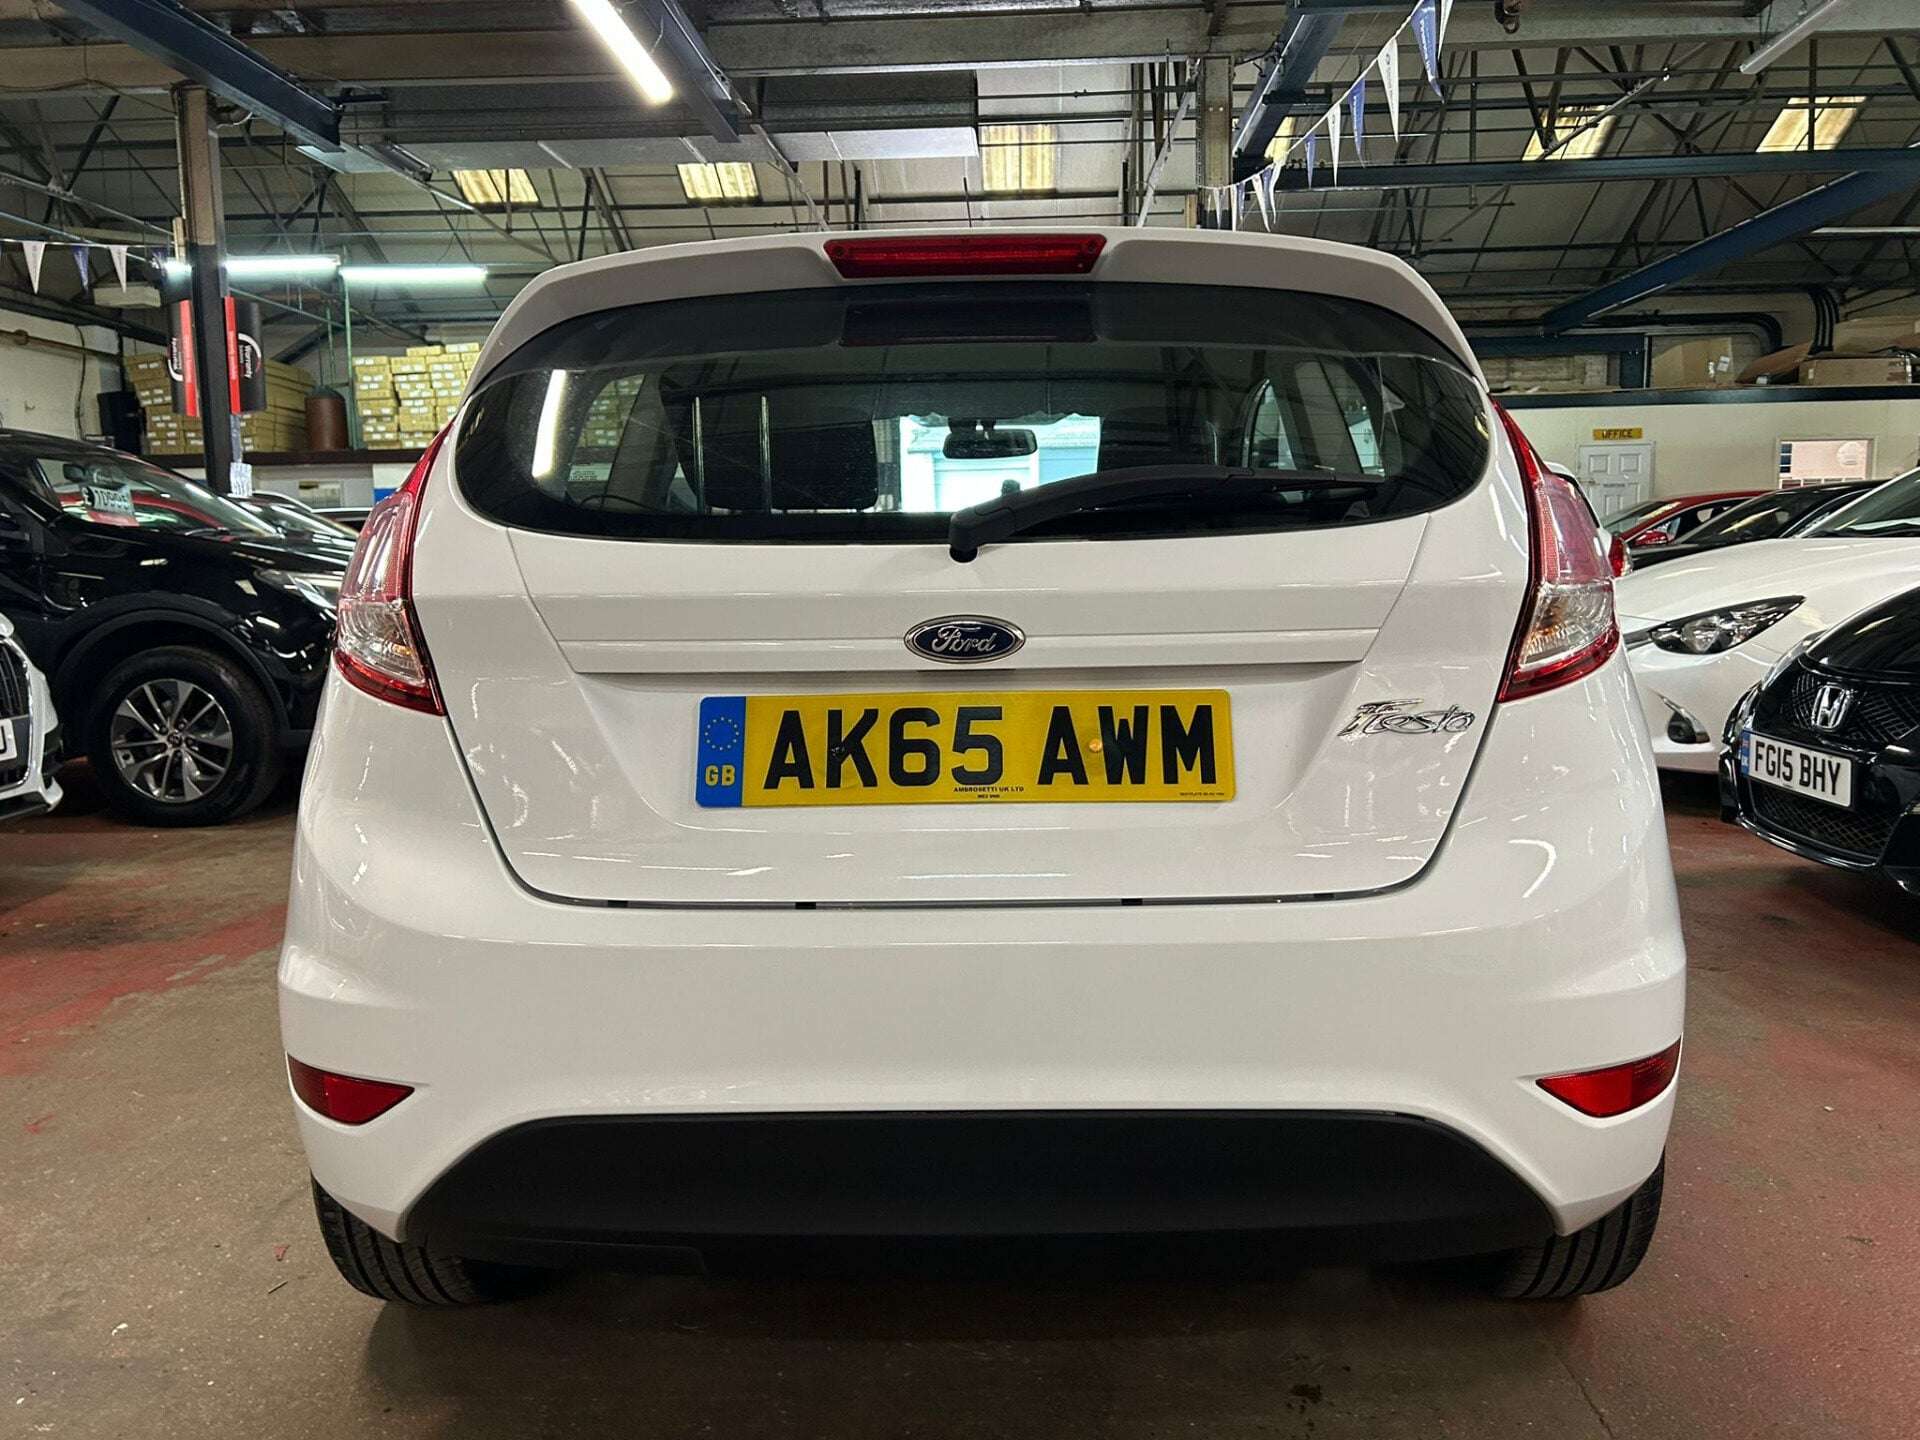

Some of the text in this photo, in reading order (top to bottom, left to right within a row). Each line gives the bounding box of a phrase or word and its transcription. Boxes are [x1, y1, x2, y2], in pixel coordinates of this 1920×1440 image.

[244, 345, 252, 378] Warranty
[931, 625, 997, 652] Ford
[763, 704, 1217, 790] AK65 AWM
[705, 765, 736, 787] GB
[1754, 740, 1841, 796] FG15 BHY
